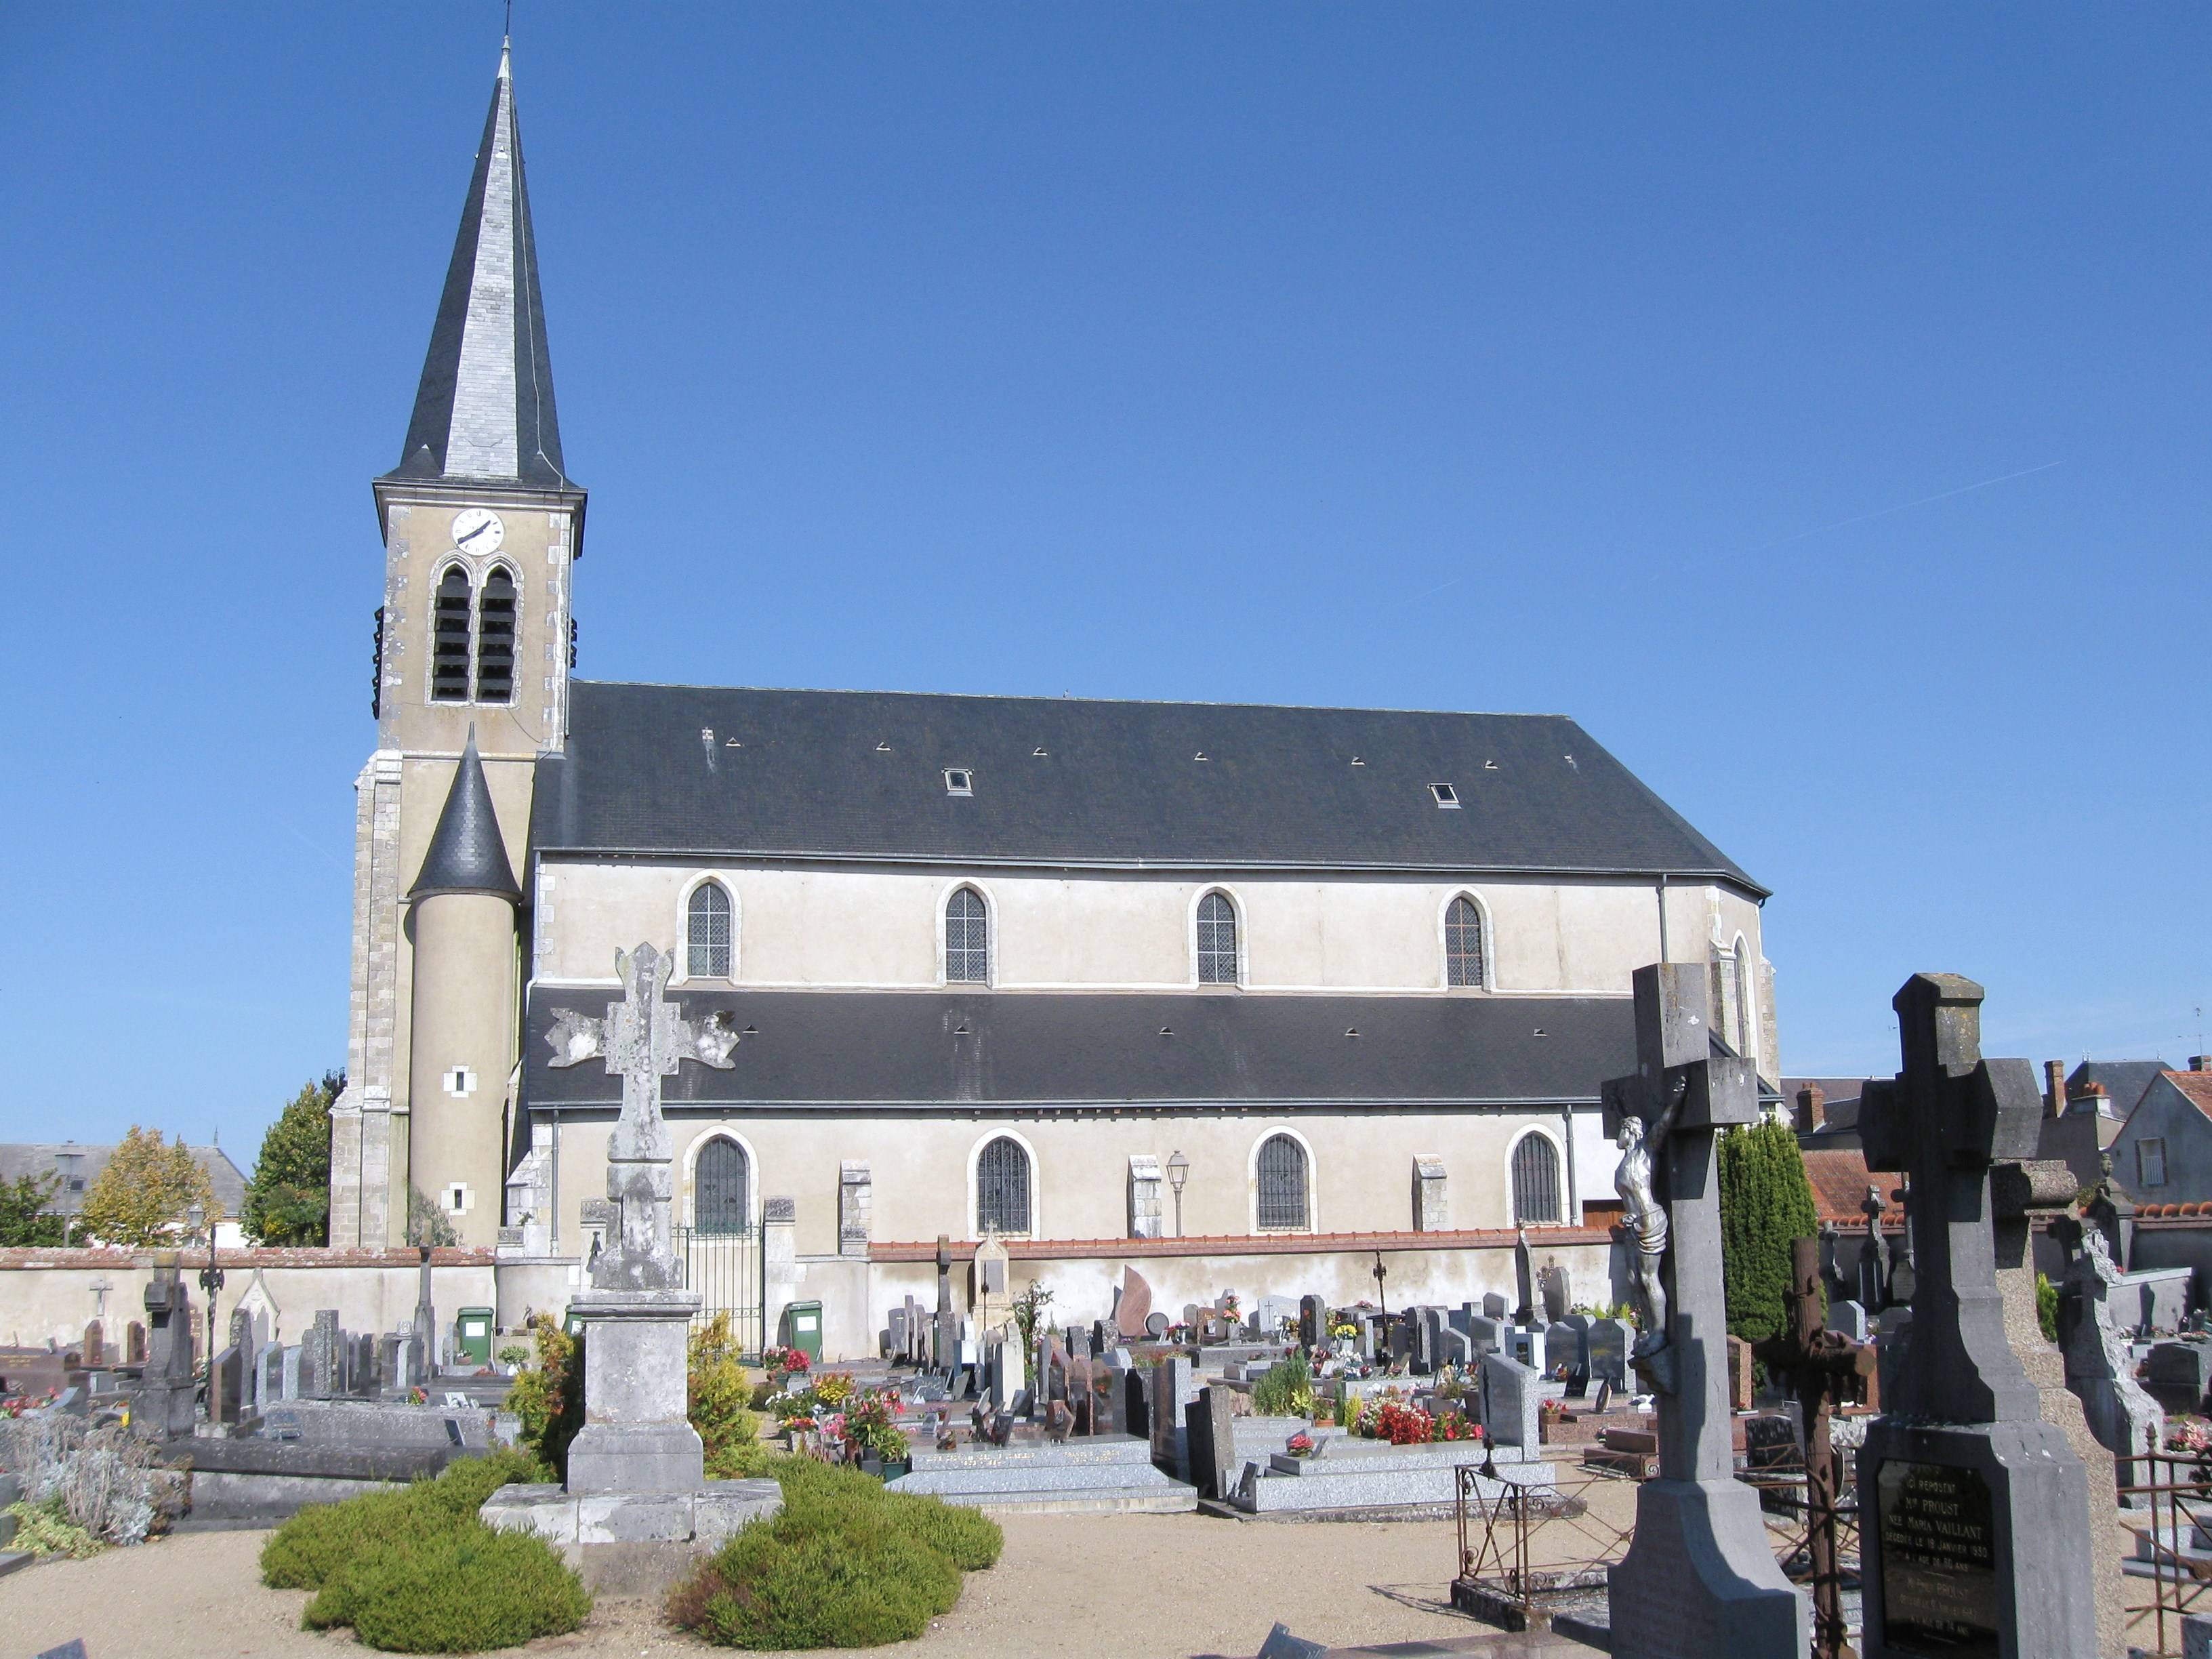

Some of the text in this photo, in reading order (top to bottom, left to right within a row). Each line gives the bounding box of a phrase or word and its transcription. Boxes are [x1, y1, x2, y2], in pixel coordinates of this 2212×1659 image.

[1919, 1479, 1957, 1494] REPOSENT
[1922, 1499, 1959, 1517] PROUST
[1908, 1516, 1932, 1532] MARIA
[1936, 1520, 1983, 1540] VAILLANT
[1938, 1539, 1967, 1554] JANVIER
